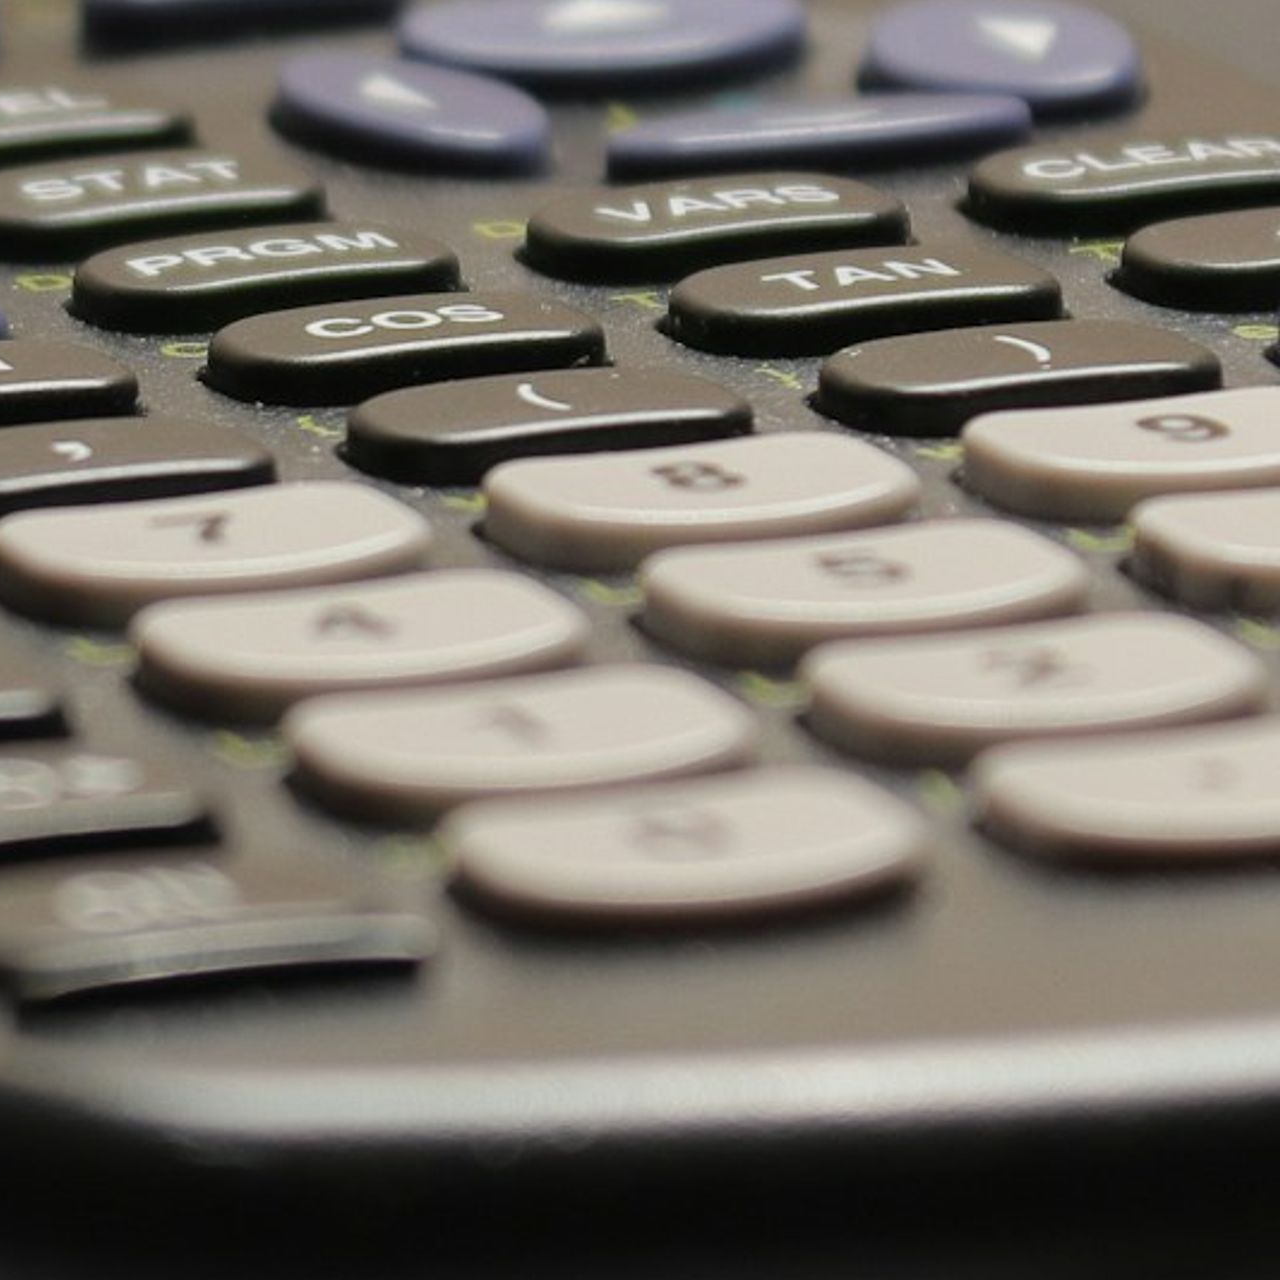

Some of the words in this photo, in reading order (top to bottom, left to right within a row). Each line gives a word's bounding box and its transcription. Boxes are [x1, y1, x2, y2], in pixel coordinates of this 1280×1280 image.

[20, 160, 238, 200] STAT
[594, 185, 840, 222] VARS
[127, 231, 400, 276] PRGM
[761, 257, 961, 291] TAN
[305, 304, 504, 338] COS
[1135, 413, 1231, 442] 9
[651, 460, 747, 491] 8
